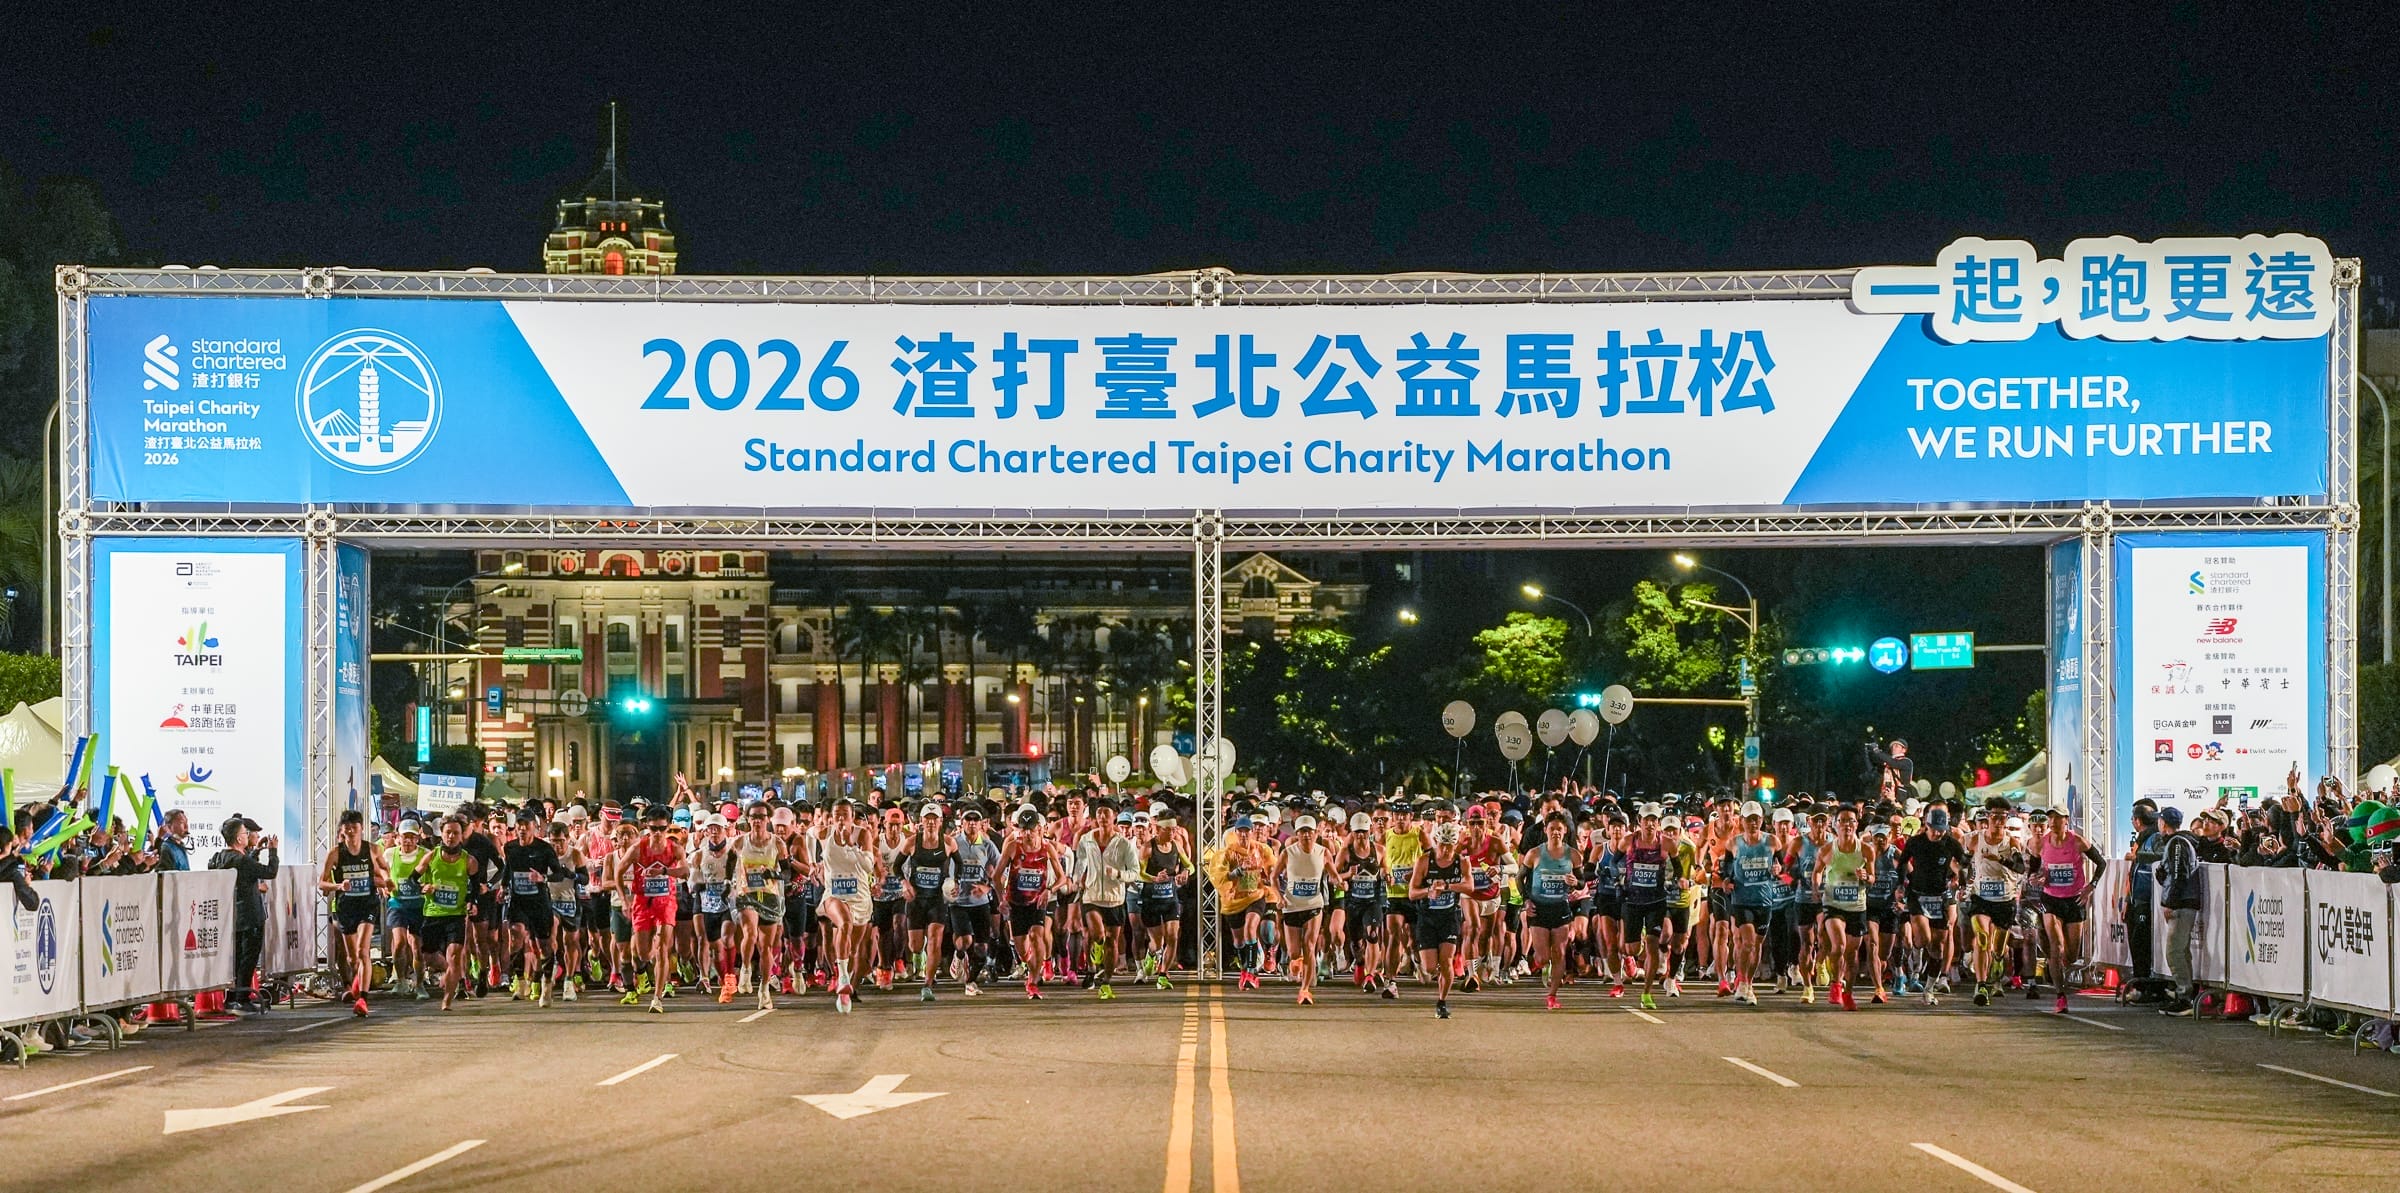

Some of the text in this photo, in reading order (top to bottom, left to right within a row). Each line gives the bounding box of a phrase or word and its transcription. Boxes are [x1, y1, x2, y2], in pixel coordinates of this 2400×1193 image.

[1870, 251, 2319, 326] 一起，跑更遠
[192, 338, 281, 354] standard
[192, 354, 287, 370] chartered
[192, 372, 261, 389] 渣打銀行
[640, 328, 1776, 421] 2026 渣打臺北公益馬拉松
[1907, 375, 2140, 414] TOGETHER,
[143, 400, 260, 419] Taipei Charity
[144, 418, 227, 432] Marathon
[144, 436, 261, 450] 渣打臺北公益馬拉松
[1907, 420, 2272, 460] WE RUN FURTHER
[144, 453, 179, 465] 2026
[744, 438, 1670, 484] Standard Chartered Taipei Charity Marathon
[2210, 571, 2249, 579] standard
[2210, 578, 2251, 586] chartered
[174, 654, 222, 666] TAIPEI
[191, 704, 237, 715] 中華民國
[190, 717, 237, 728] 路跑協會
